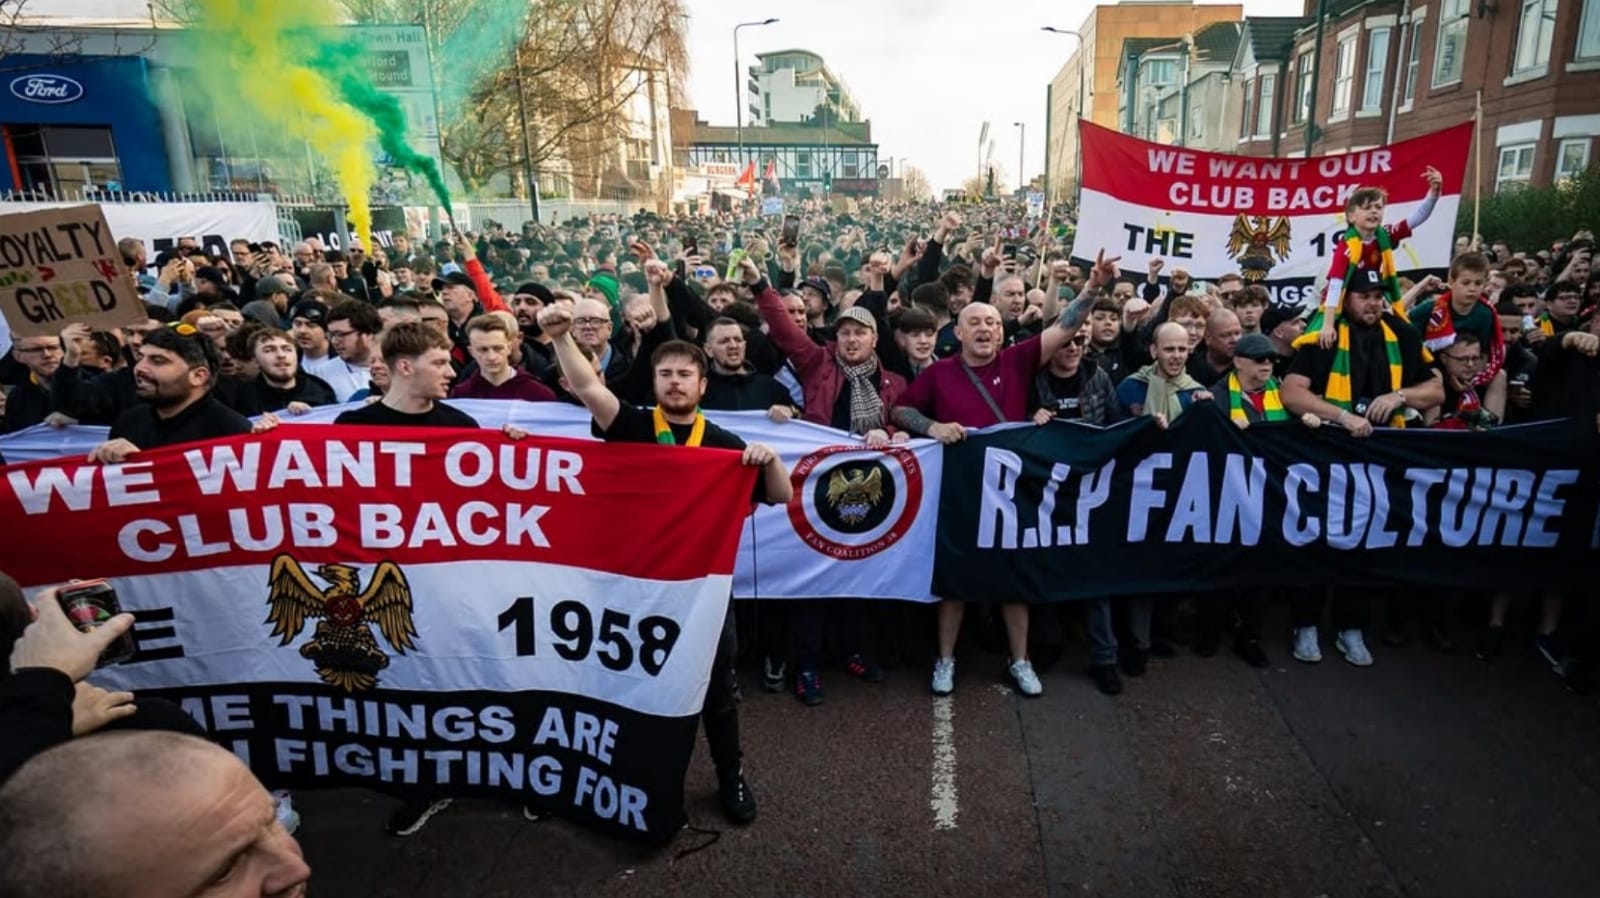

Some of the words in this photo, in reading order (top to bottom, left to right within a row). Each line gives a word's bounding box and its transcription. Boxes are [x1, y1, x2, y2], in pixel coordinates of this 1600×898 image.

[396, 31, 421, 42] Hall
[25, 78, 68, 97] Ford
[1147, 148, 1196, 174] WE
[1209, 158, 1306, 180] WANT
[1318, 149, 1392, 177] OUR
[1168, 182, 1255, 210] CLUB
[1267, 183, 1359, 211] BACK
[0, 220, 104, 269] OYALTY
[1124, 223, 1194, 259] THE
[7, 462, 161, 515] WE
[184, 440, 426, 495] WANT
[444, 448, 586, 495] OUR
[1126, 452, 1266, 546] FAN
[1281, 462, 1580, 550] CULTURE
[117, 502, 338, 563] CLUB
[360, 501, 551, 549] BACK
[827, 541, 885, 558] COALITION
[498, 597, 680, 677] 1958
[273, 694, 515, 742] THINGS
[533, 708, 620, 767] ARE
[275, 738, 565, 796] FIGHTING
[575, 765, 649, 832] FOR
